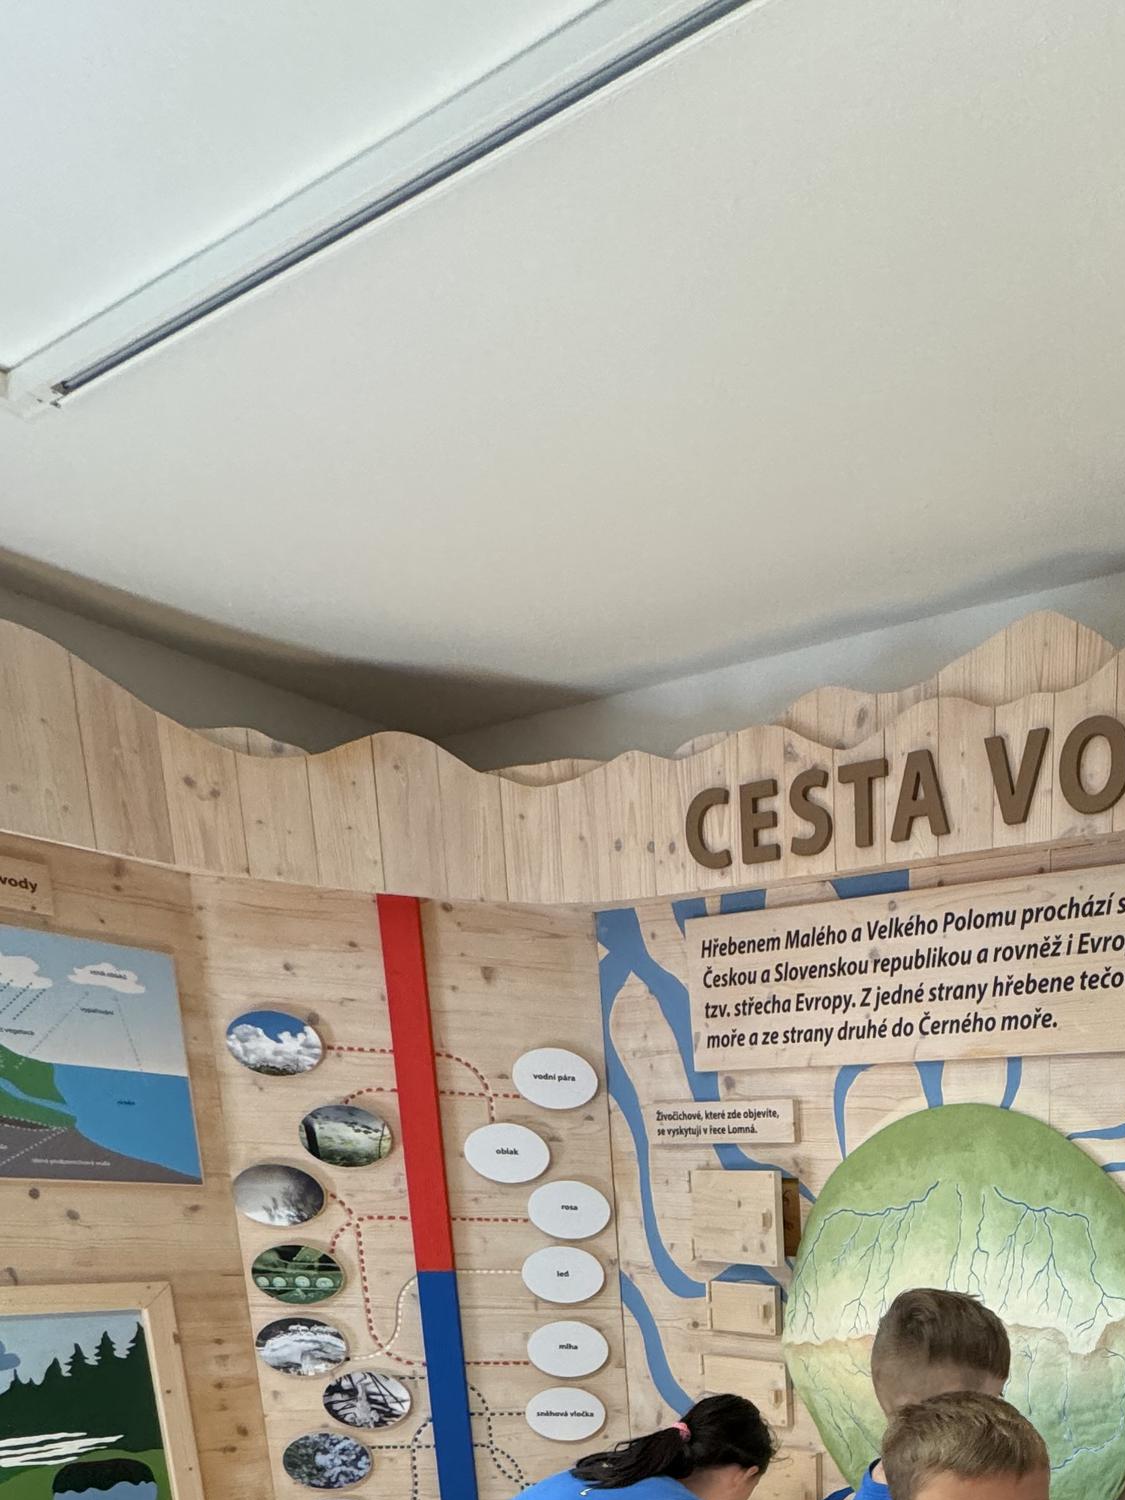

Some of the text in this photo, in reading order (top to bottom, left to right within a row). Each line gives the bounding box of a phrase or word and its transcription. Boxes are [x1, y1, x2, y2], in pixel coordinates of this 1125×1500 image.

[685, 749, 950, 870] CESTA
[701, 936, 781, 959] Hřebenem
[785, 924, 847, 950] Malého
[851, 927, 862, 943] a
[867, 914, 938, 941] Velkého
[942, 908, 1017, 933] Polomu
[1020, 891, 1114, 930] prochází
[703, 966, 757, 989] Českou
[760, 969, 770, 984] a
[774, 956, 869, 983] Slovenskou
[873, 946, 972, 978] republikou
[976, 947, 989, 964] a
[993, 934, 1062, 963] rovněž
[1066, 933, 1073, 956] i
[704, 1002, 731, 1019] tzv.
[734, 994, 791, 1017] střecha
[795, 992, 856, 1015] Evropy.
[860, 987, 872, 1007] Z
[873, 982, 924, 1012] jedné
[928, 982, 988, 1005] strany
[992, 972, 1075, 998] hřebene
[707, 1007, 1058, 1049] moře a ze strany druhé do Černého moře.
[533, 1073, 576, 1082] vodní pára
[656, 1110, 704, 1121] Živočichové,
[704, 1110, 725, 1120] které
[727, 1109, 742, 1119] zde
[657, 1128, 665, 1136] se
[709, 1126, 726, 1134] řece
[727, 1124, 758, 1134] Lomná.
[556, 1270, 570, 1278] led
